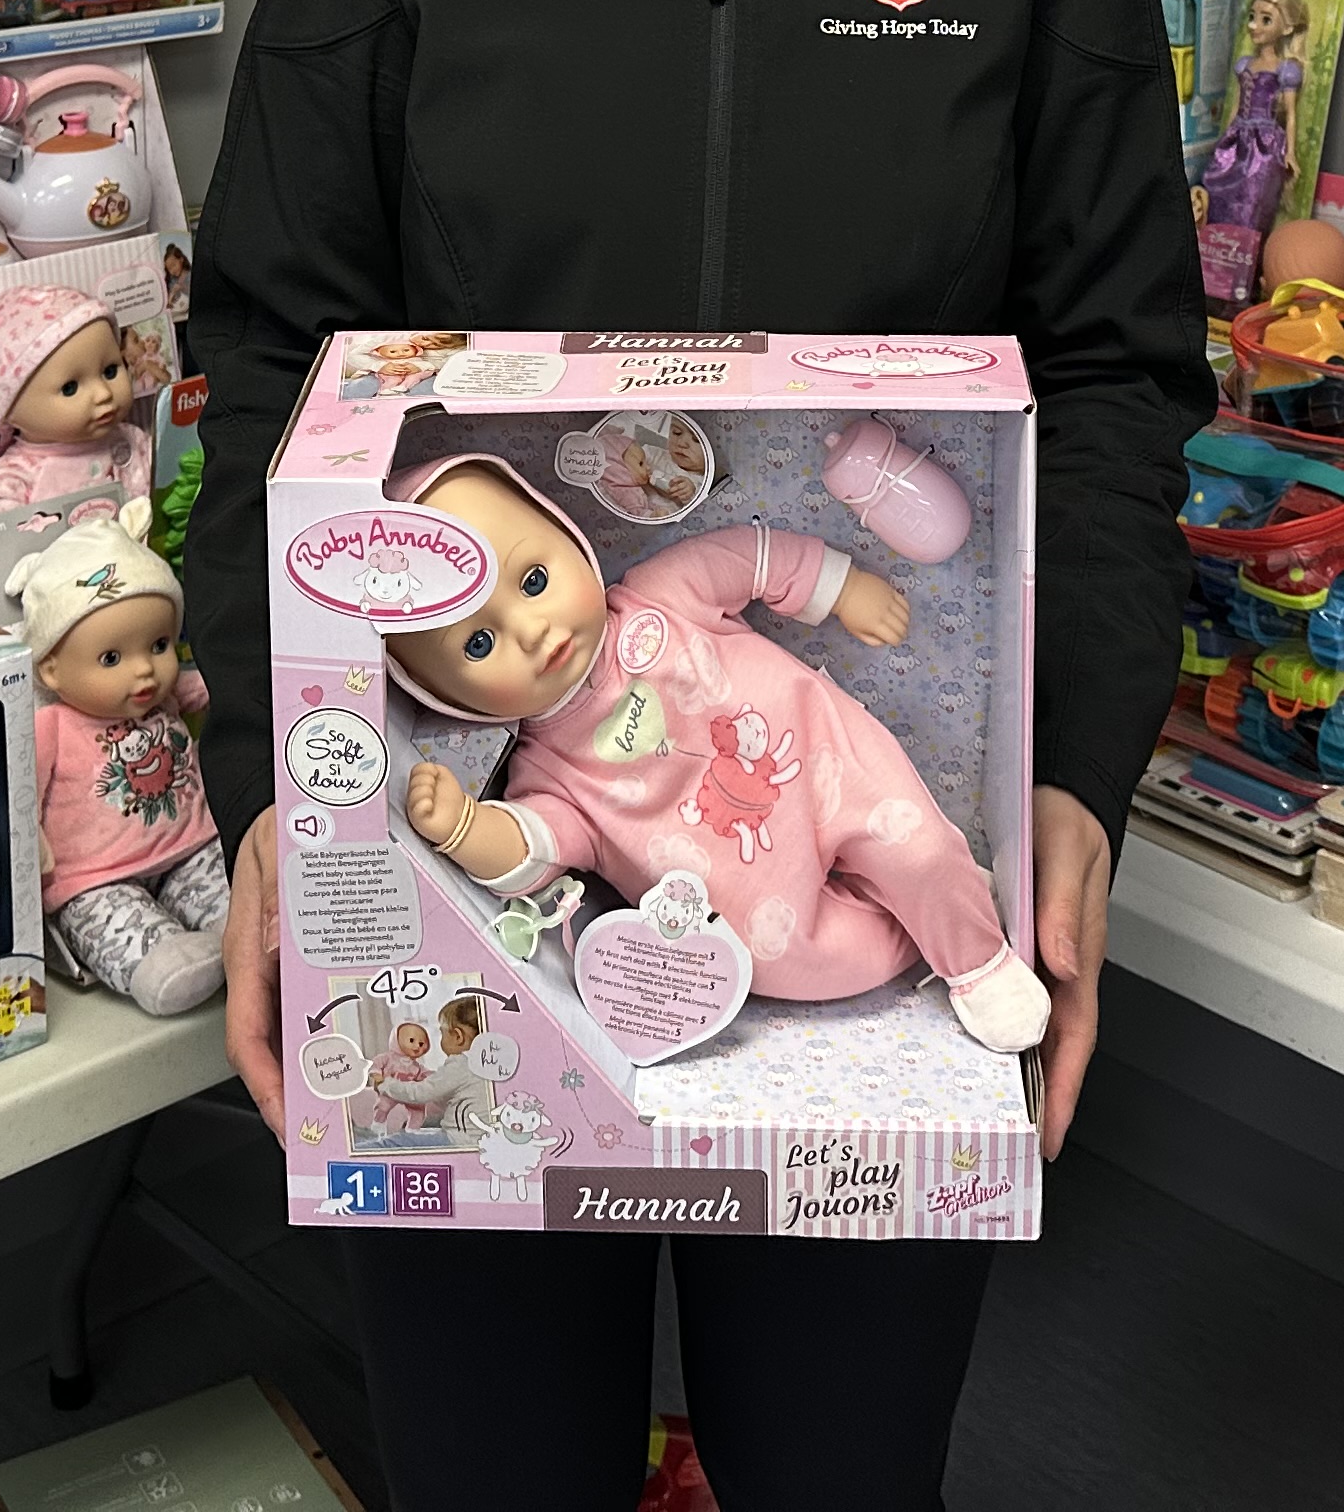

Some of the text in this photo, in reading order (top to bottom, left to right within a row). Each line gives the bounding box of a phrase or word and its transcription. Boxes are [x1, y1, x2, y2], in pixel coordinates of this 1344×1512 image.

[820, 19, 978, 39] Giving Hope Today
[588, 333, 744, 351] Hannah
[804, 342, 980, 365] Baby Annabell
[657, 360, 727, 379] play
[613, 370, 724, 393] Jouons
[296, 516, 470, 575] Baby Annabell
[1, 672, 28, 687] 6m+
[615, 691, 647, 753] loved
[305, 737, 365, 764] Soft
[308, 773, 362, 793] doux
[784, 1140, 853, 1171] Let's
[407, 1171, 440, 1194] 36
[829, 1159, 901, 1202] play
[405, 1193, 442, 1211] cm
[573, 1186, 741, 1225] Hannah
[785, 1186, 896, 1230] Jouons
